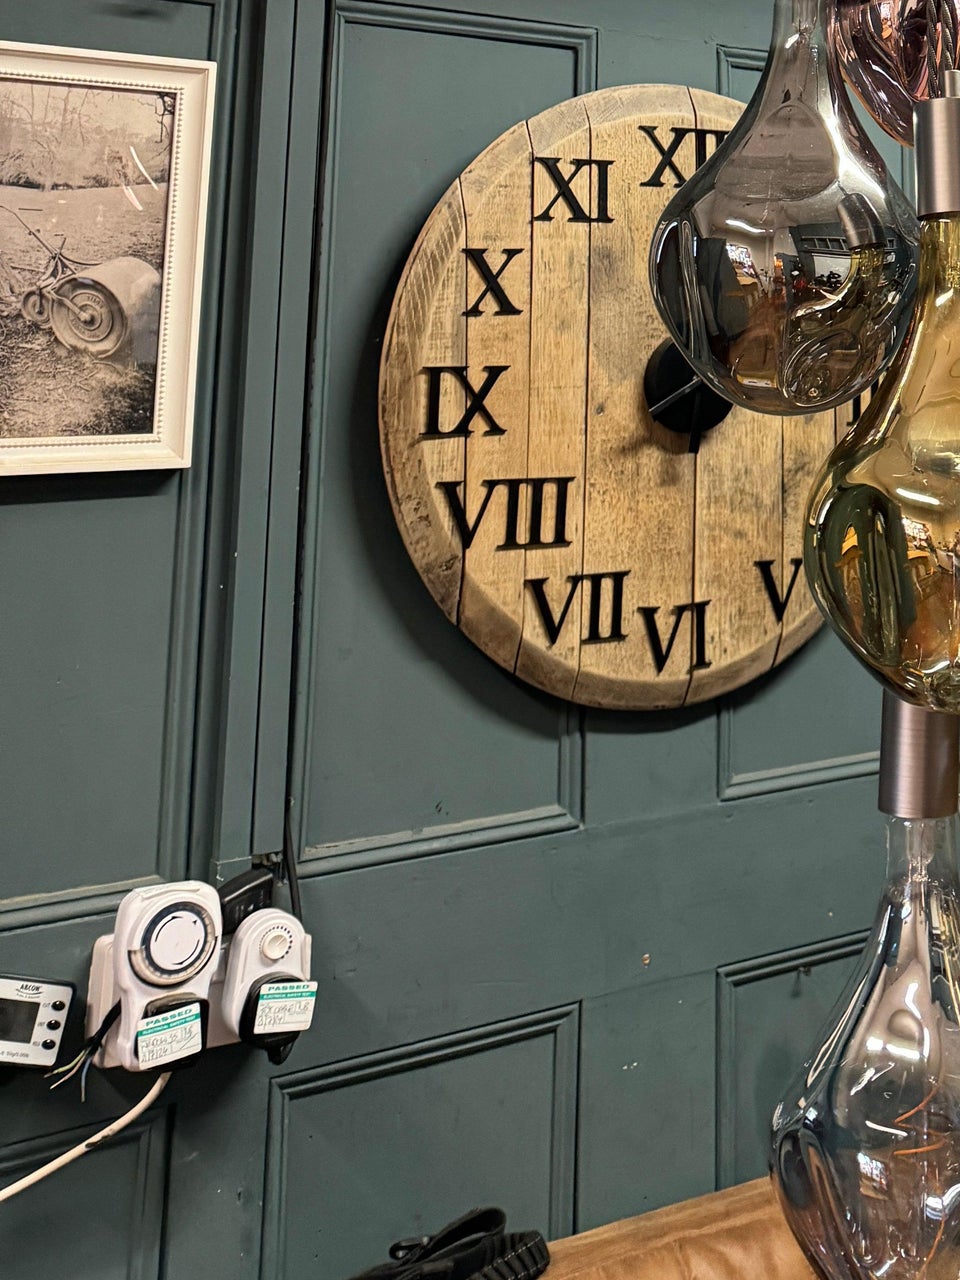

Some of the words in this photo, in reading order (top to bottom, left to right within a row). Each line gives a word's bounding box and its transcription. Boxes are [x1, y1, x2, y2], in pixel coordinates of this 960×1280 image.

[533, 156, 616, 224] XI
[461, 248, 526, 318] X
[419, 365, 512, 441] IX
[434, 476, 577, 552] VIII
[524, 569, 632, 647] VII
[753, 557, 804, 626] V
[636, 599, 713, 677] VI
[145, 1008, 193, 1027] PASSED
[267, 984, 310, 992] PASSED
